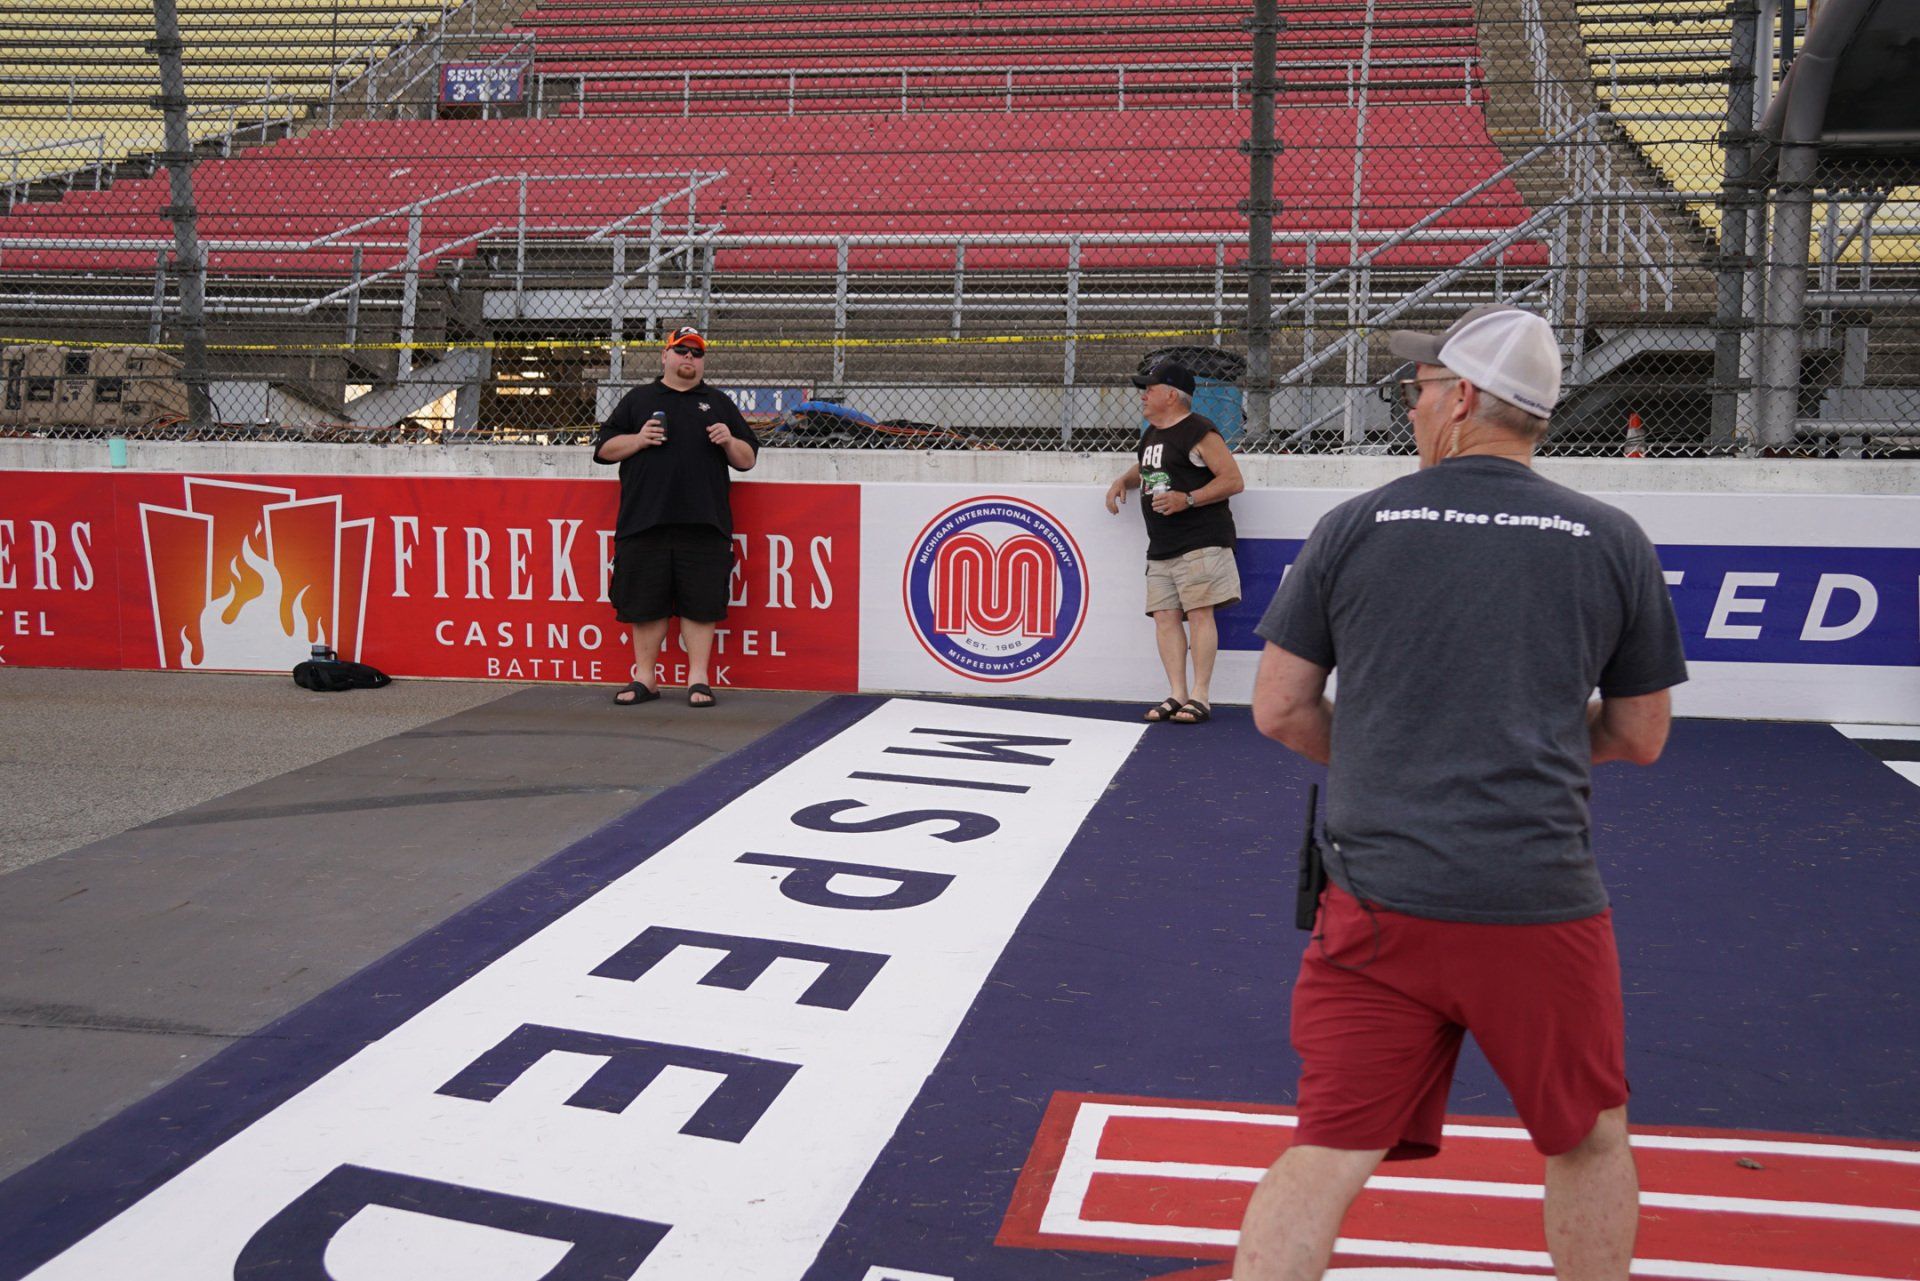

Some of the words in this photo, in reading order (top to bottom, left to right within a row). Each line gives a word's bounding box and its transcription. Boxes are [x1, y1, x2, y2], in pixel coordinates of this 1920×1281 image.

[447, 68, 519, 82] SECTIONS
[772, 390, 783, 412] 1
[1375, 506, 1440, 523] Hassle
[1444, 509, 1490, 524] Free
[1494, 512, 1591, 537] Camping.
[920, 521, 955, 565] MICHIGAN
[954, 507, 1032, 525] INTERNATIONAL
[435, 620, 603, 651] CASINO
[660, 627, 786, 657] TEL
[487, 657, 602, 681] BATTLE
[630, 663, 731, 685] CREK
[948, 648, 1041, 671] MISPEEDWAY.COM
